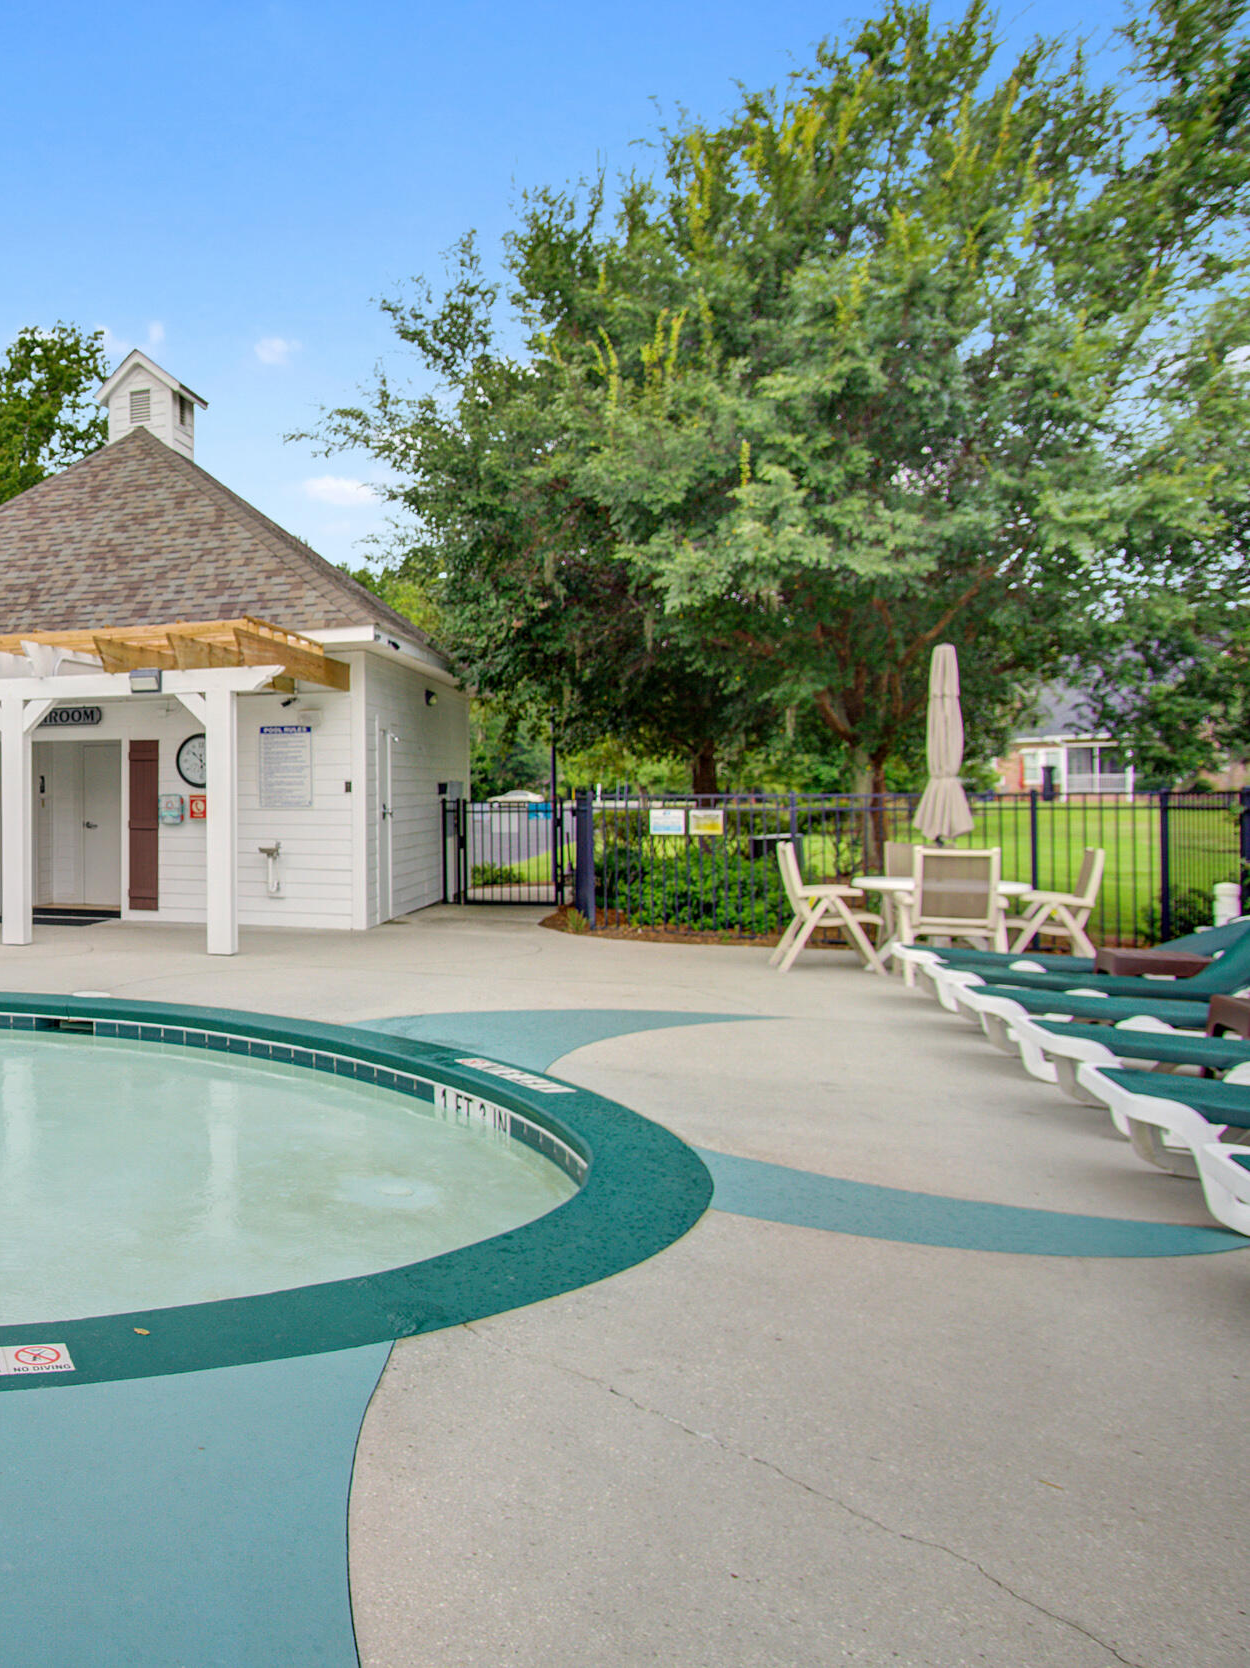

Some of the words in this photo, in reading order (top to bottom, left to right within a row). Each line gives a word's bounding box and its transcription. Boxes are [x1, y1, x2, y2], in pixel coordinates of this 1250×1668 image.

[456, 1093, 472, 1117] FT
[492, 1107, 507, 1132] IN
[33, 1363, 71, 1371] DIVING
